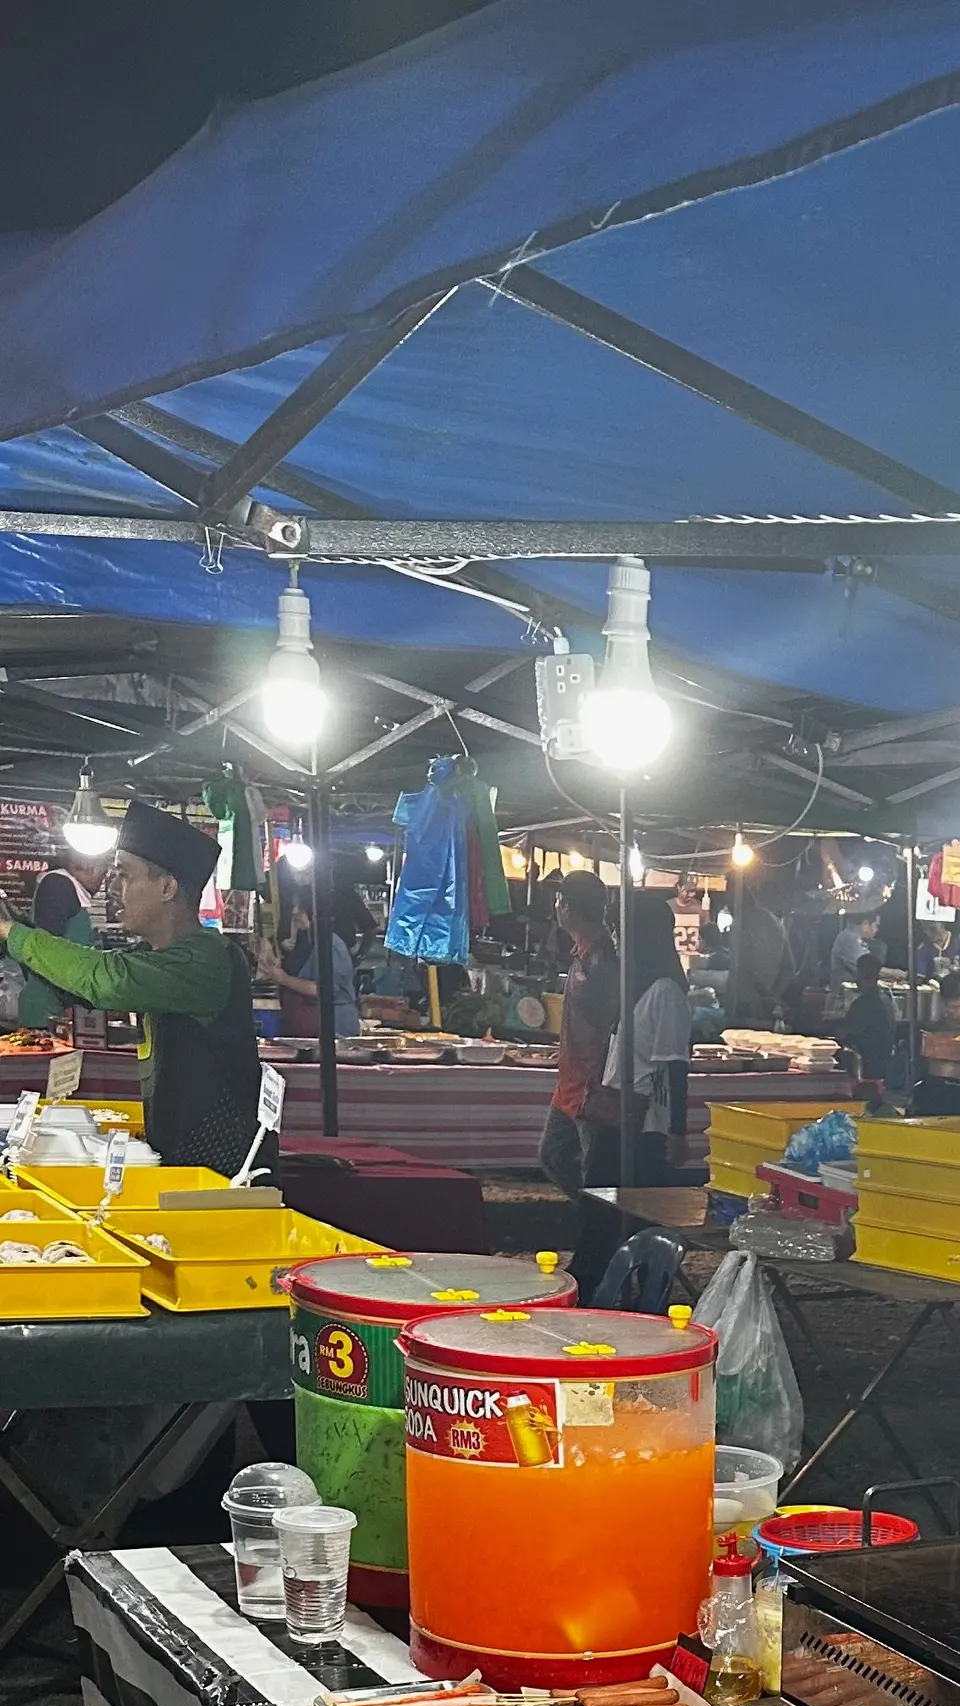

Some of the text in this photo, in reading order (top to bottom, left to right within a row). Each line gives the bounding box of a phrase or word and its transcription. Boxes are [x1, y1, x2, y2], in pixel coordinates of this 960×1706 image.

[0, 803, 47, 817] KURMA
[673, 926, 701, 952] 23
[316, 1375, 369, 1399] SEBUNGKUS
[451, 1427, 481, 1451] RM3
